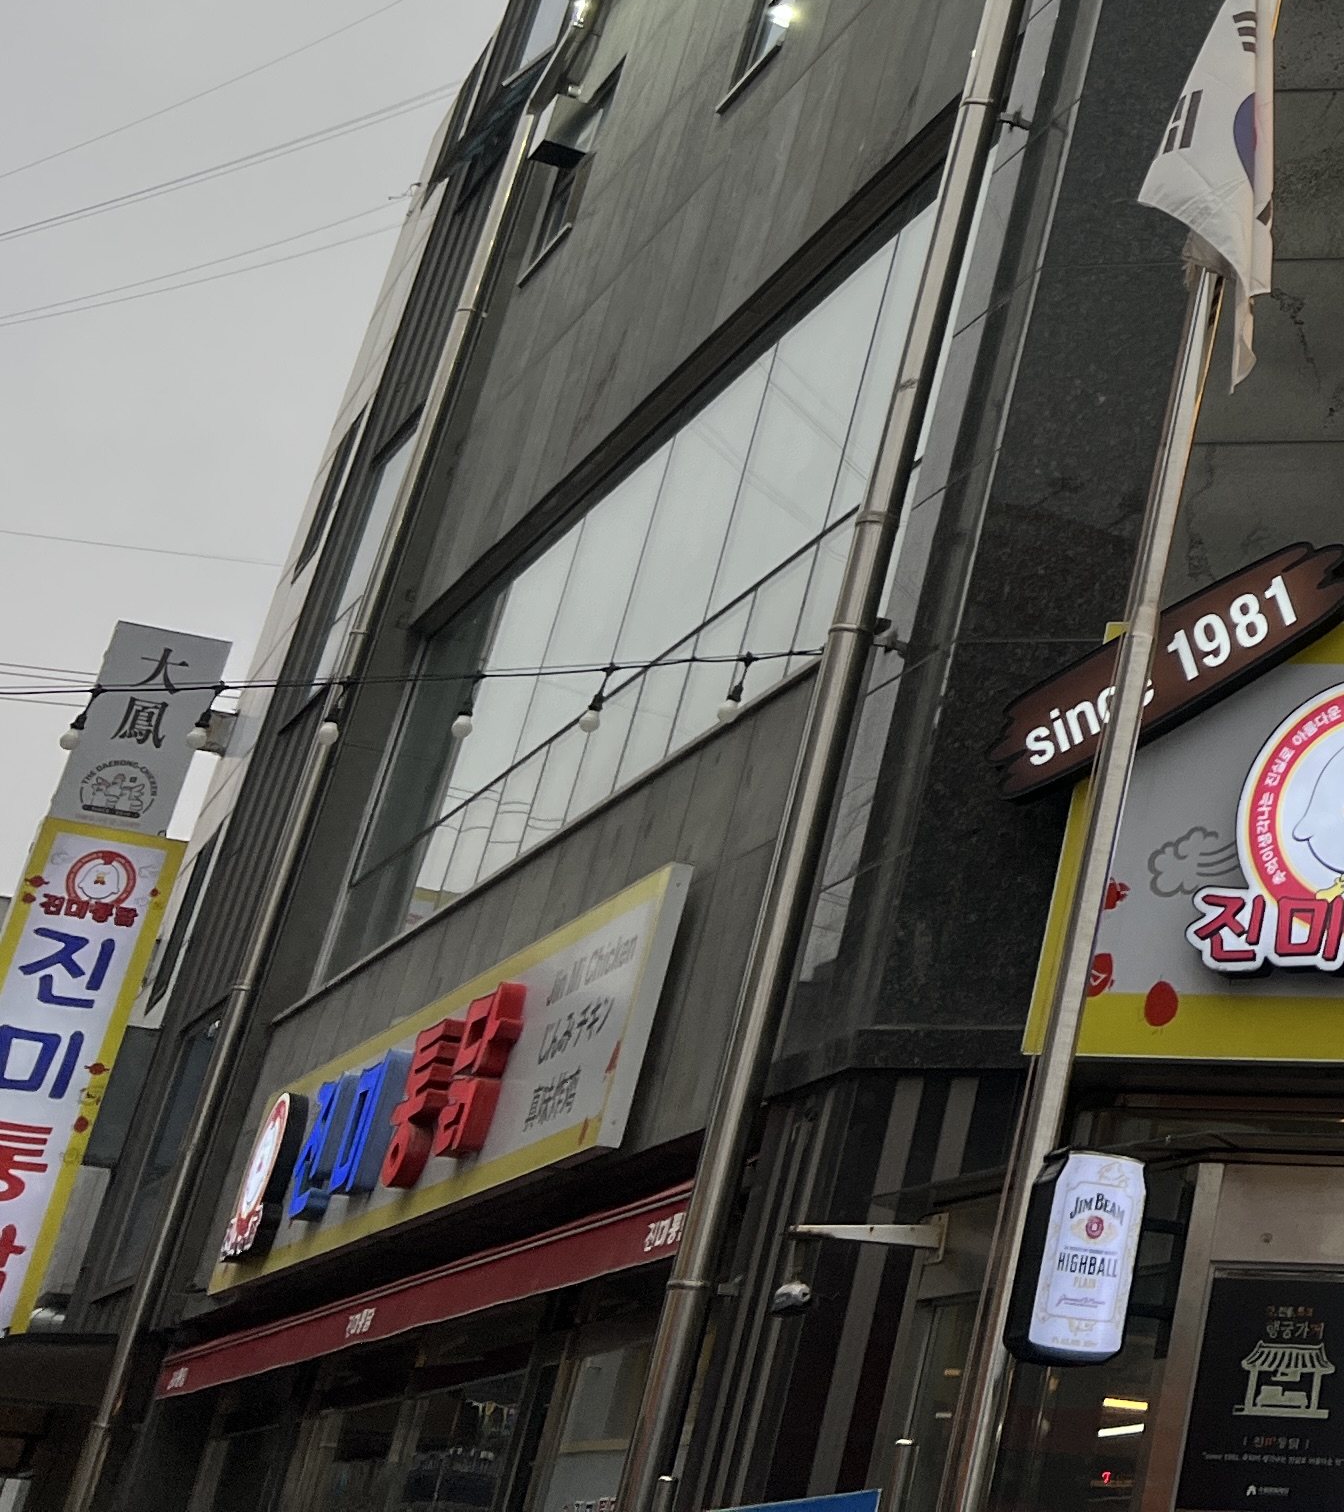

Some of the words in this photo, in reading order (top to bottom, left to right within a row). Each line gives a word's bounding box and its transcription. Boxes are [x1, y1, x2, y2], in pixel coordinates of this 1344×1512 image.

[1167, 575, 1297, 681] 1981
[1264, 746, 1295, 786] 진실로
[1291, 705, 1342, 746] 아름다운
[289, 981, 527, 1221] 진미통닭
[1070, 1196, 1094, 1219] JIM
[1094, 1193, 1125, 1226] BEAM
[1056, 1252, 1118, 1278] HIGHBALL
